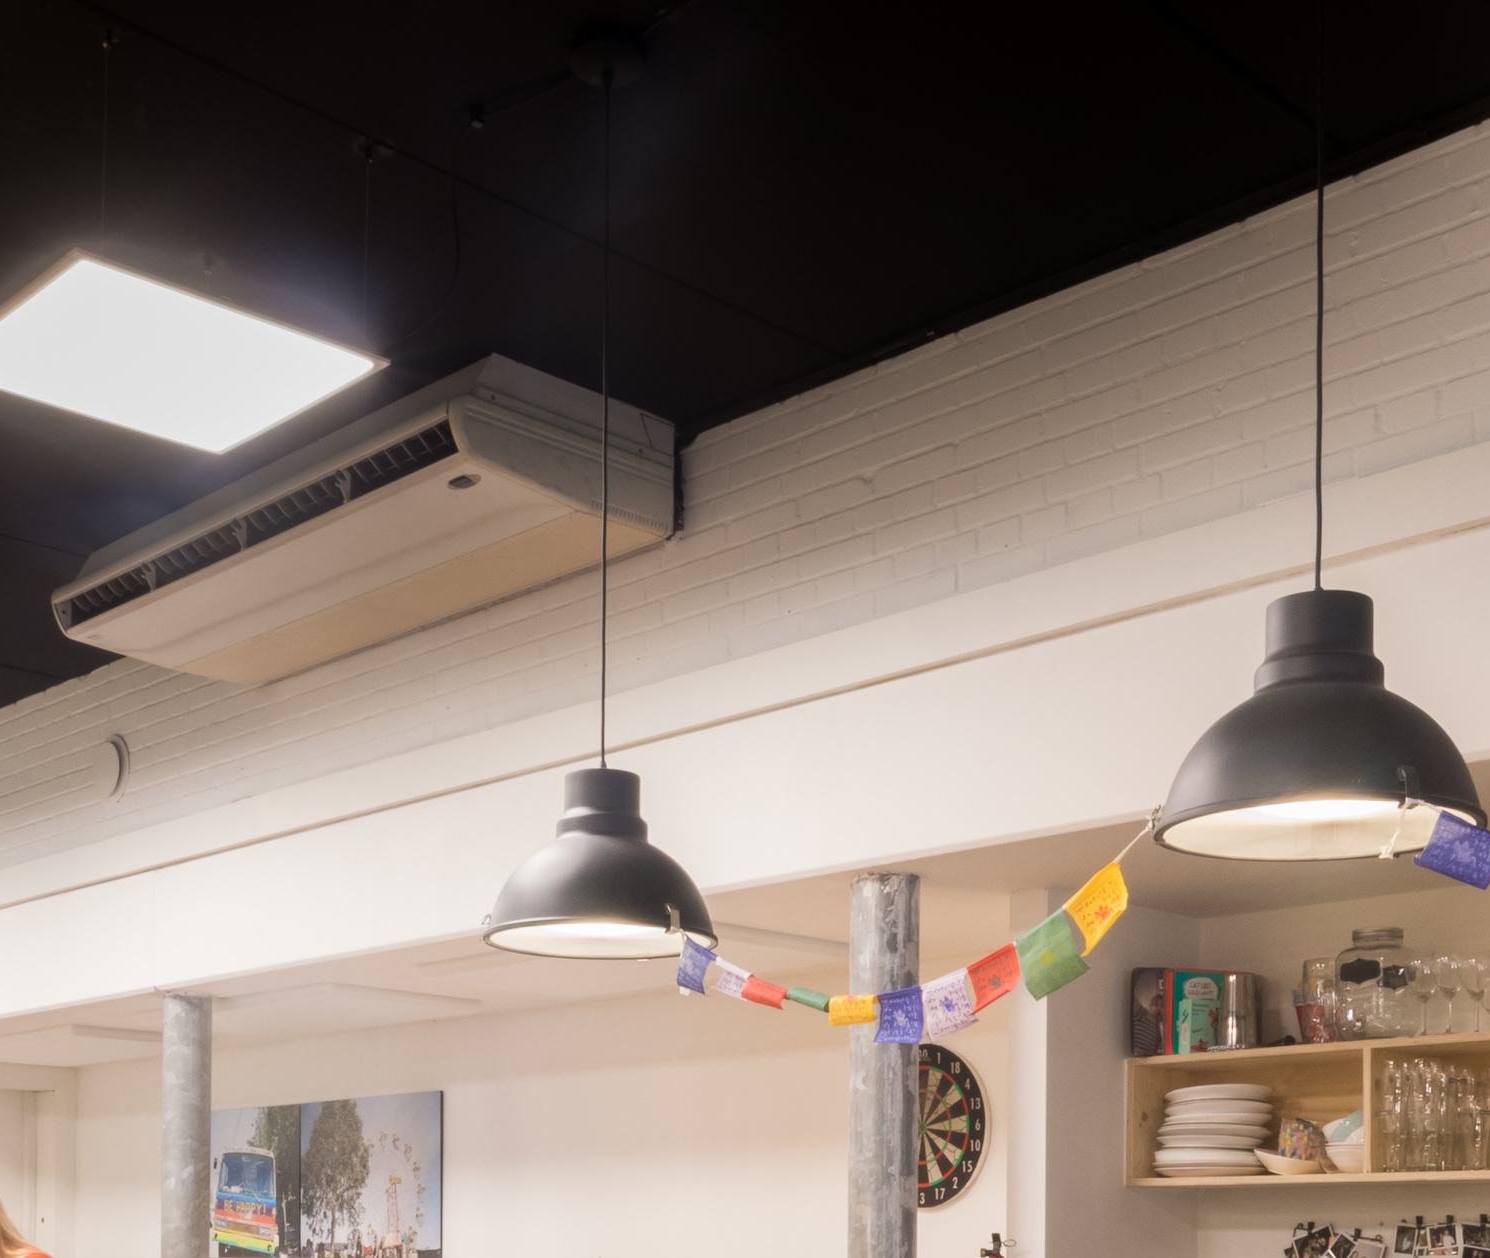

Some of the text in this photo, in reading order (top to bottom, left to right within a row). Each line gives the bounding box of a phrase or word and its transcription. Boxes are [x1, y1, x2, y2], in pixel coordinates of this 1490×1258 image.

[950, 1062, 961, 1074] 18
[965, 1078, 971, 1090] 4
[970, 1098, 981, 1110] 13
[975, 1119, 981, 1131] 6
[970, 1140, 981, 1152] 10
[962, 1160, 973, 1173] 15
[952, 1177, 958, 1189] 2
[919, 1192, 926, 1205] 3
[934, 1188, 946, 1200] 17
[223, 1199, 267, 1216] BE HAPPY!
